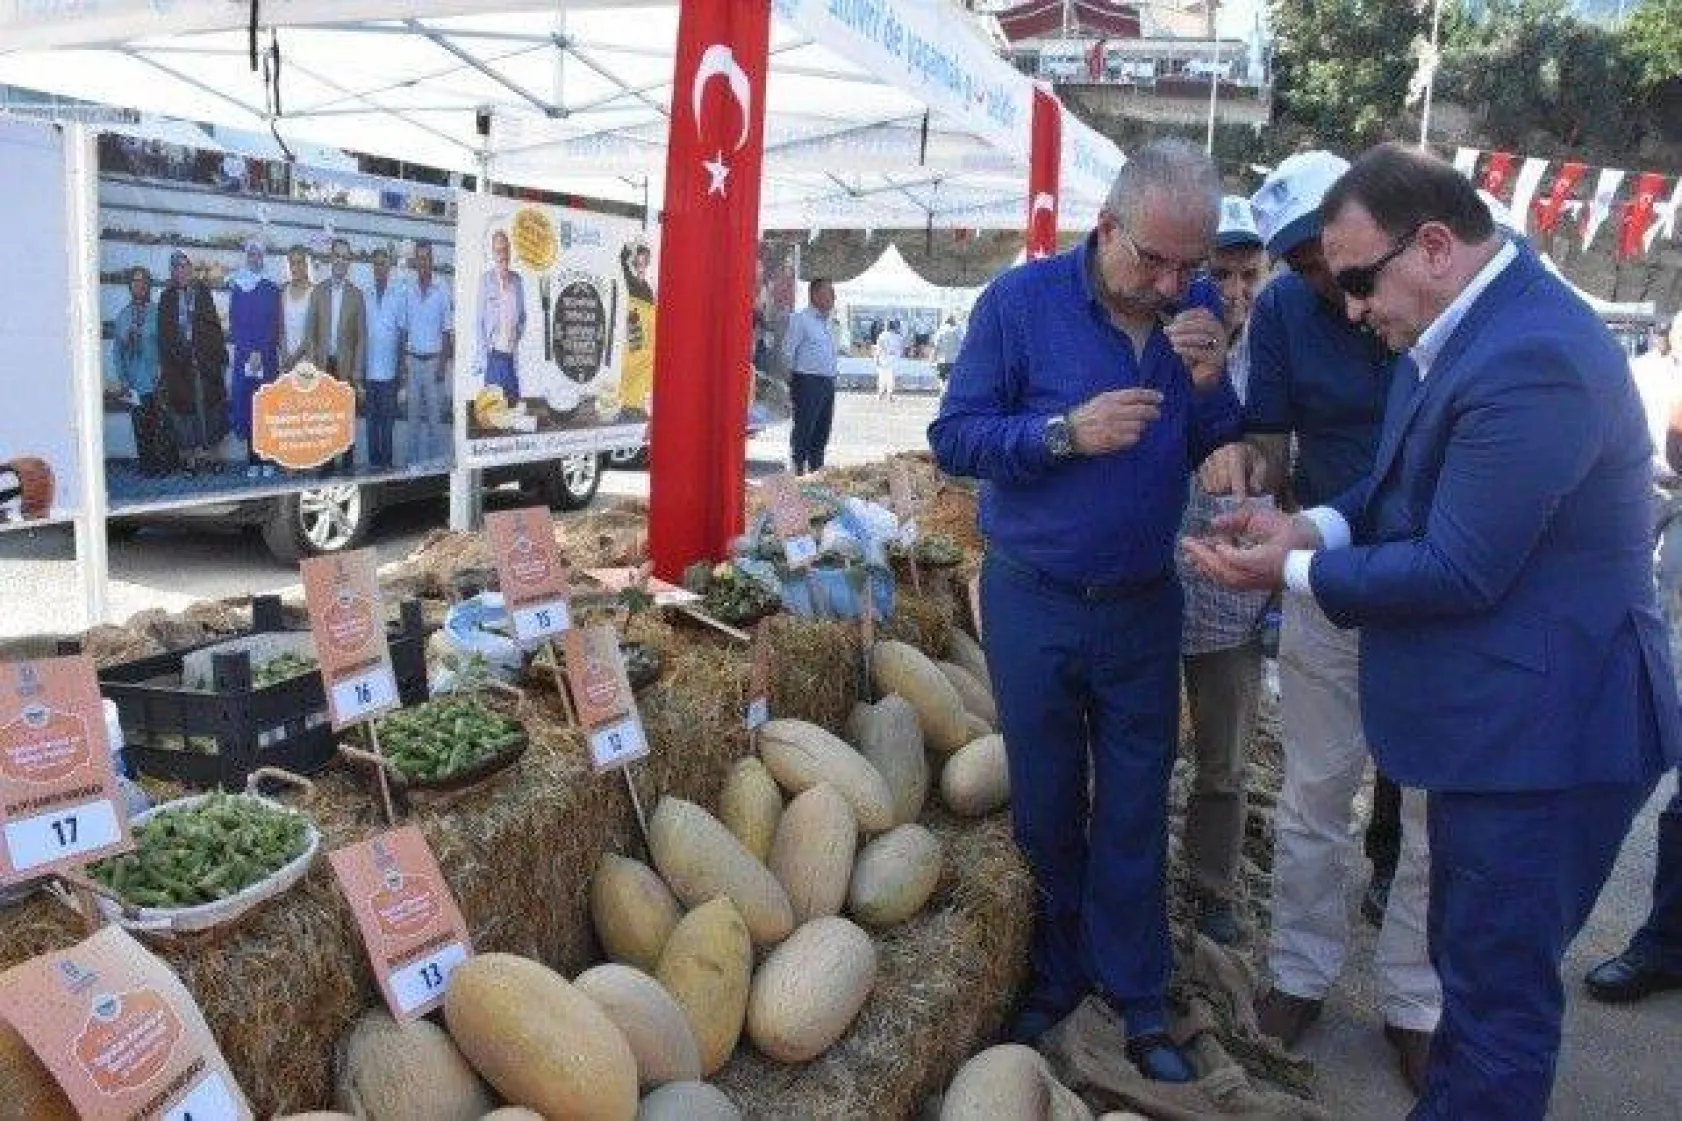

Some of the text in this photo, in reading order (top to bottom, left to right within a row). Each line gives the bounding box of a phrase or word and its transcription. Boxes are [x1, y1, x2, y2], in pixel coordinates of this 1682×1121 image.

[354, 683, 372, 705] 16
[52, 816, 77, 846] 17
[420, 963, 443, 989] 13
